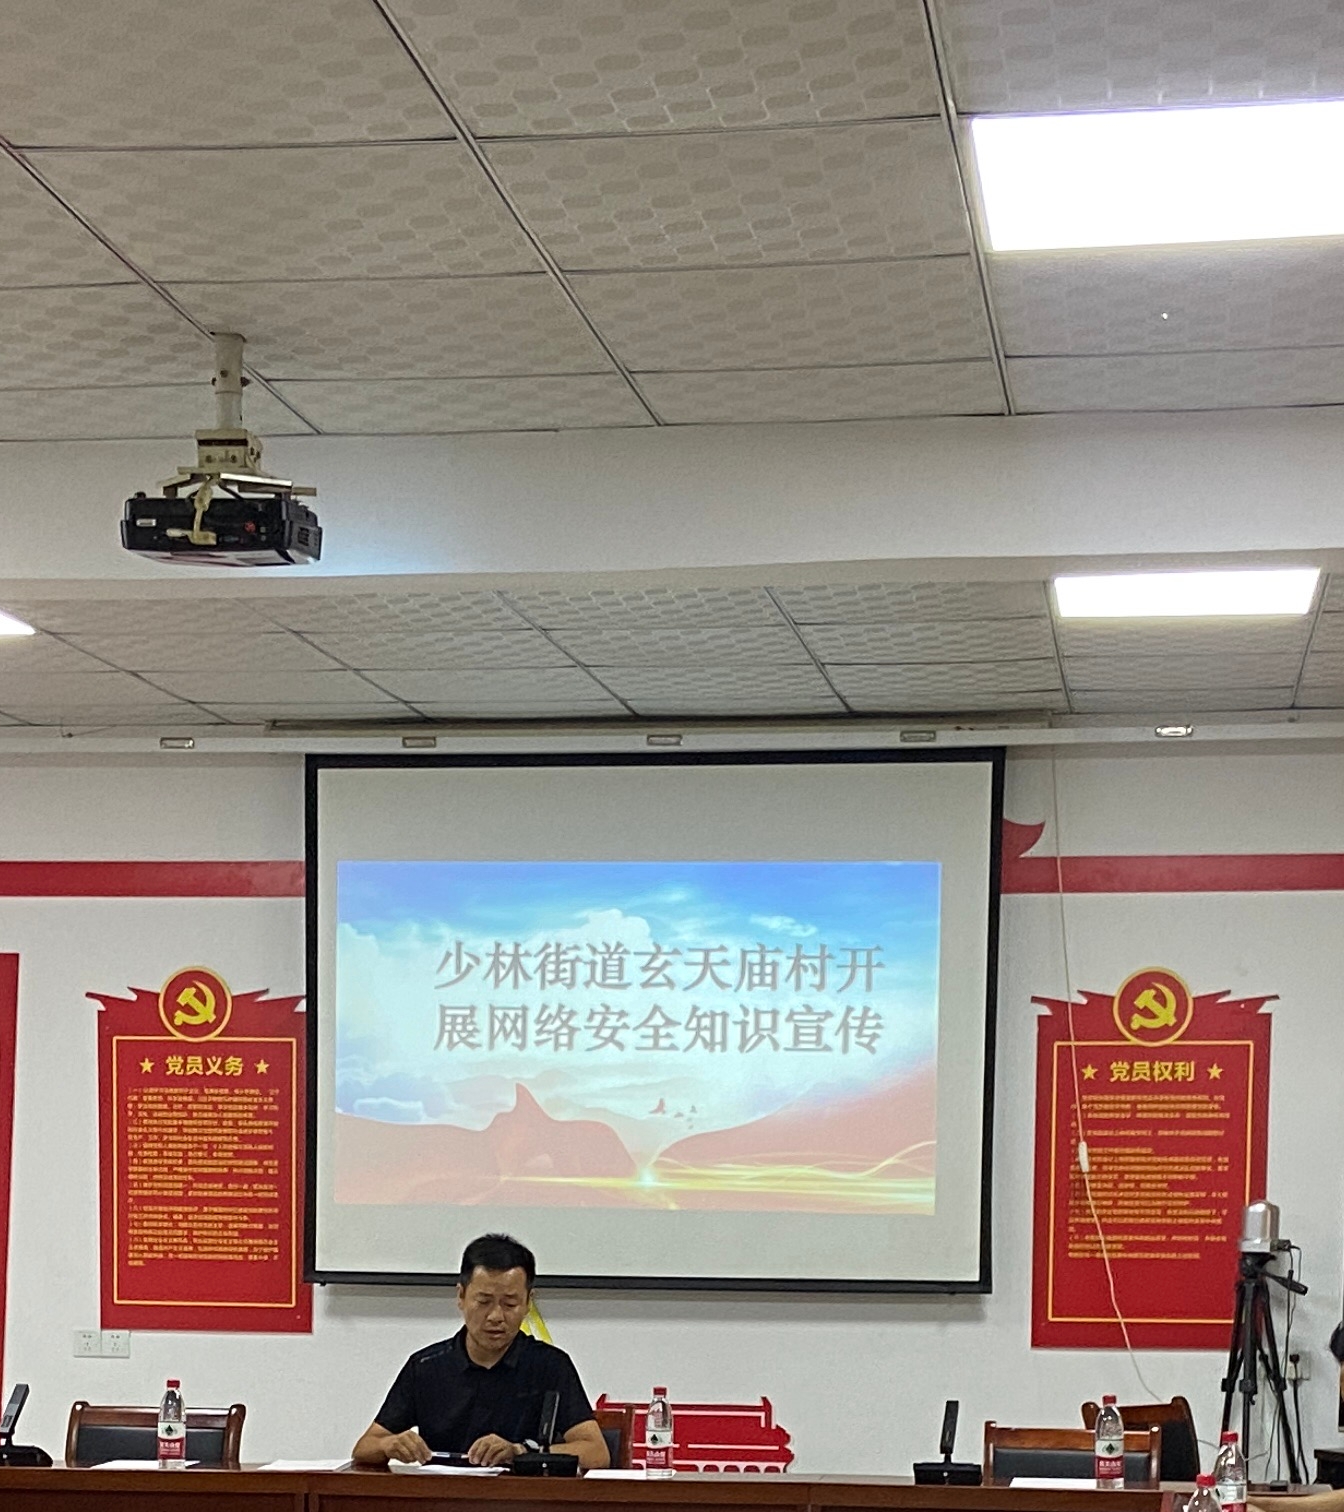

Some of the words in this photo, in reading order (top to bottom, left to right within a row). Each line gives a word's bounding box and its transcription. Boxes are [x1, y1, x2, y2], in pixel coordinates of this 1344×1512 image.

[434, 941, 885, 992] 少林街道玄天庙村开
[433, 1004, 884, 1055] 展网络安全知识宣传
[166, 1055, 244, 1076] 党员义务
[1109, 1060, 1195, 1082] 党员权利
